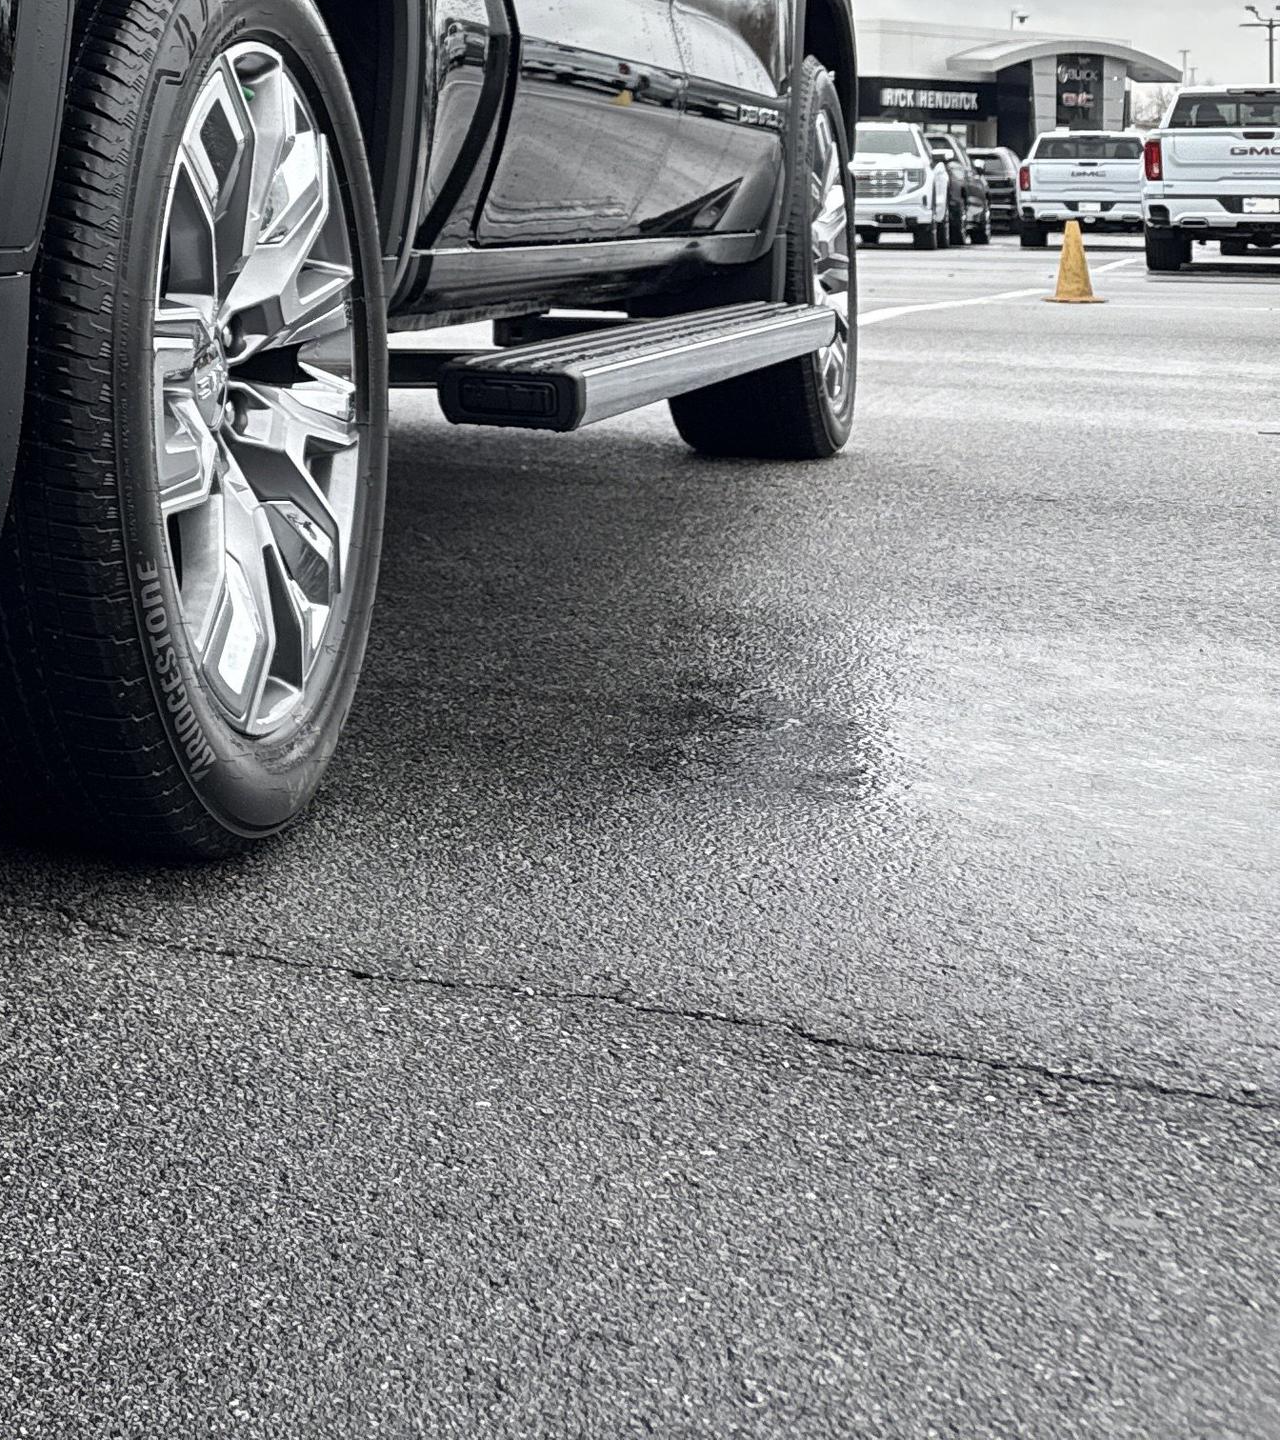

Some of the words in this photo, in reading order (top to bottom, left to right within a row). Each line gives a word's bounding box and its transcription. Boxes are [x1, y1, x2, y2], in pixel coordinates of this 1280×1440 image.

[881, 87, 915, 108] RICK
[916, 89, 978, 110] HENDRICK
[136, 558, 217, 783] BRIDGESTONE
